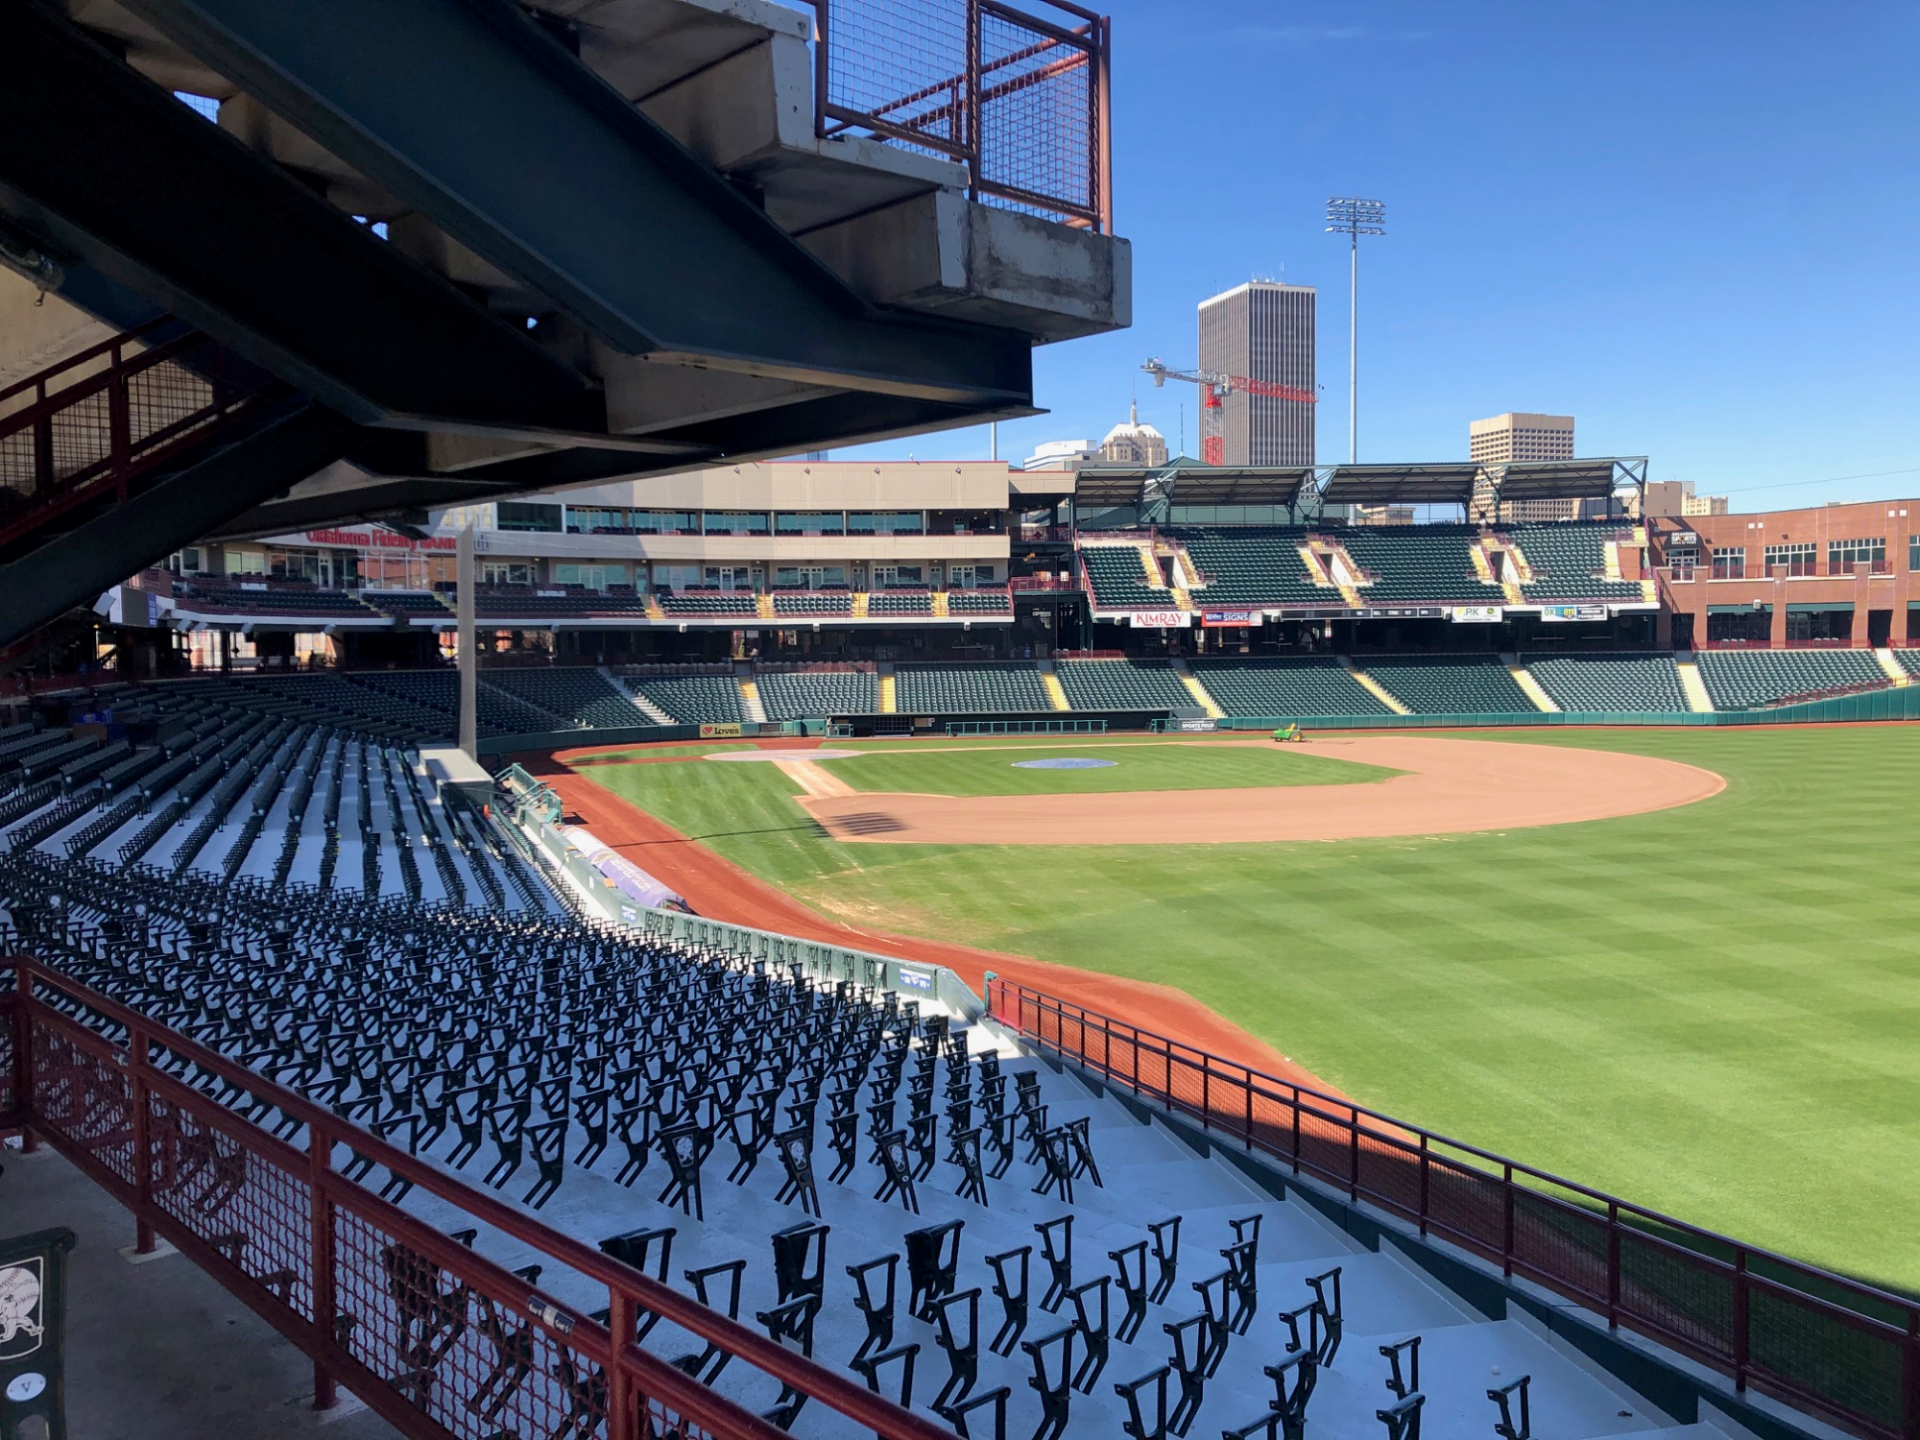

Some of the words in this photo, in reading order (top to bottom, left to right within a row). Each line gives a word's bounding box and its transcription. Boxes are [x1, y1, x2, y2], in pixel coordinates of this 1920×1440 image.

[305, 528, 371, 546] Oklahoma
[372, 529, 418, 551] Fidelity
[1136, 613, 1184, 626] KIMRAY
